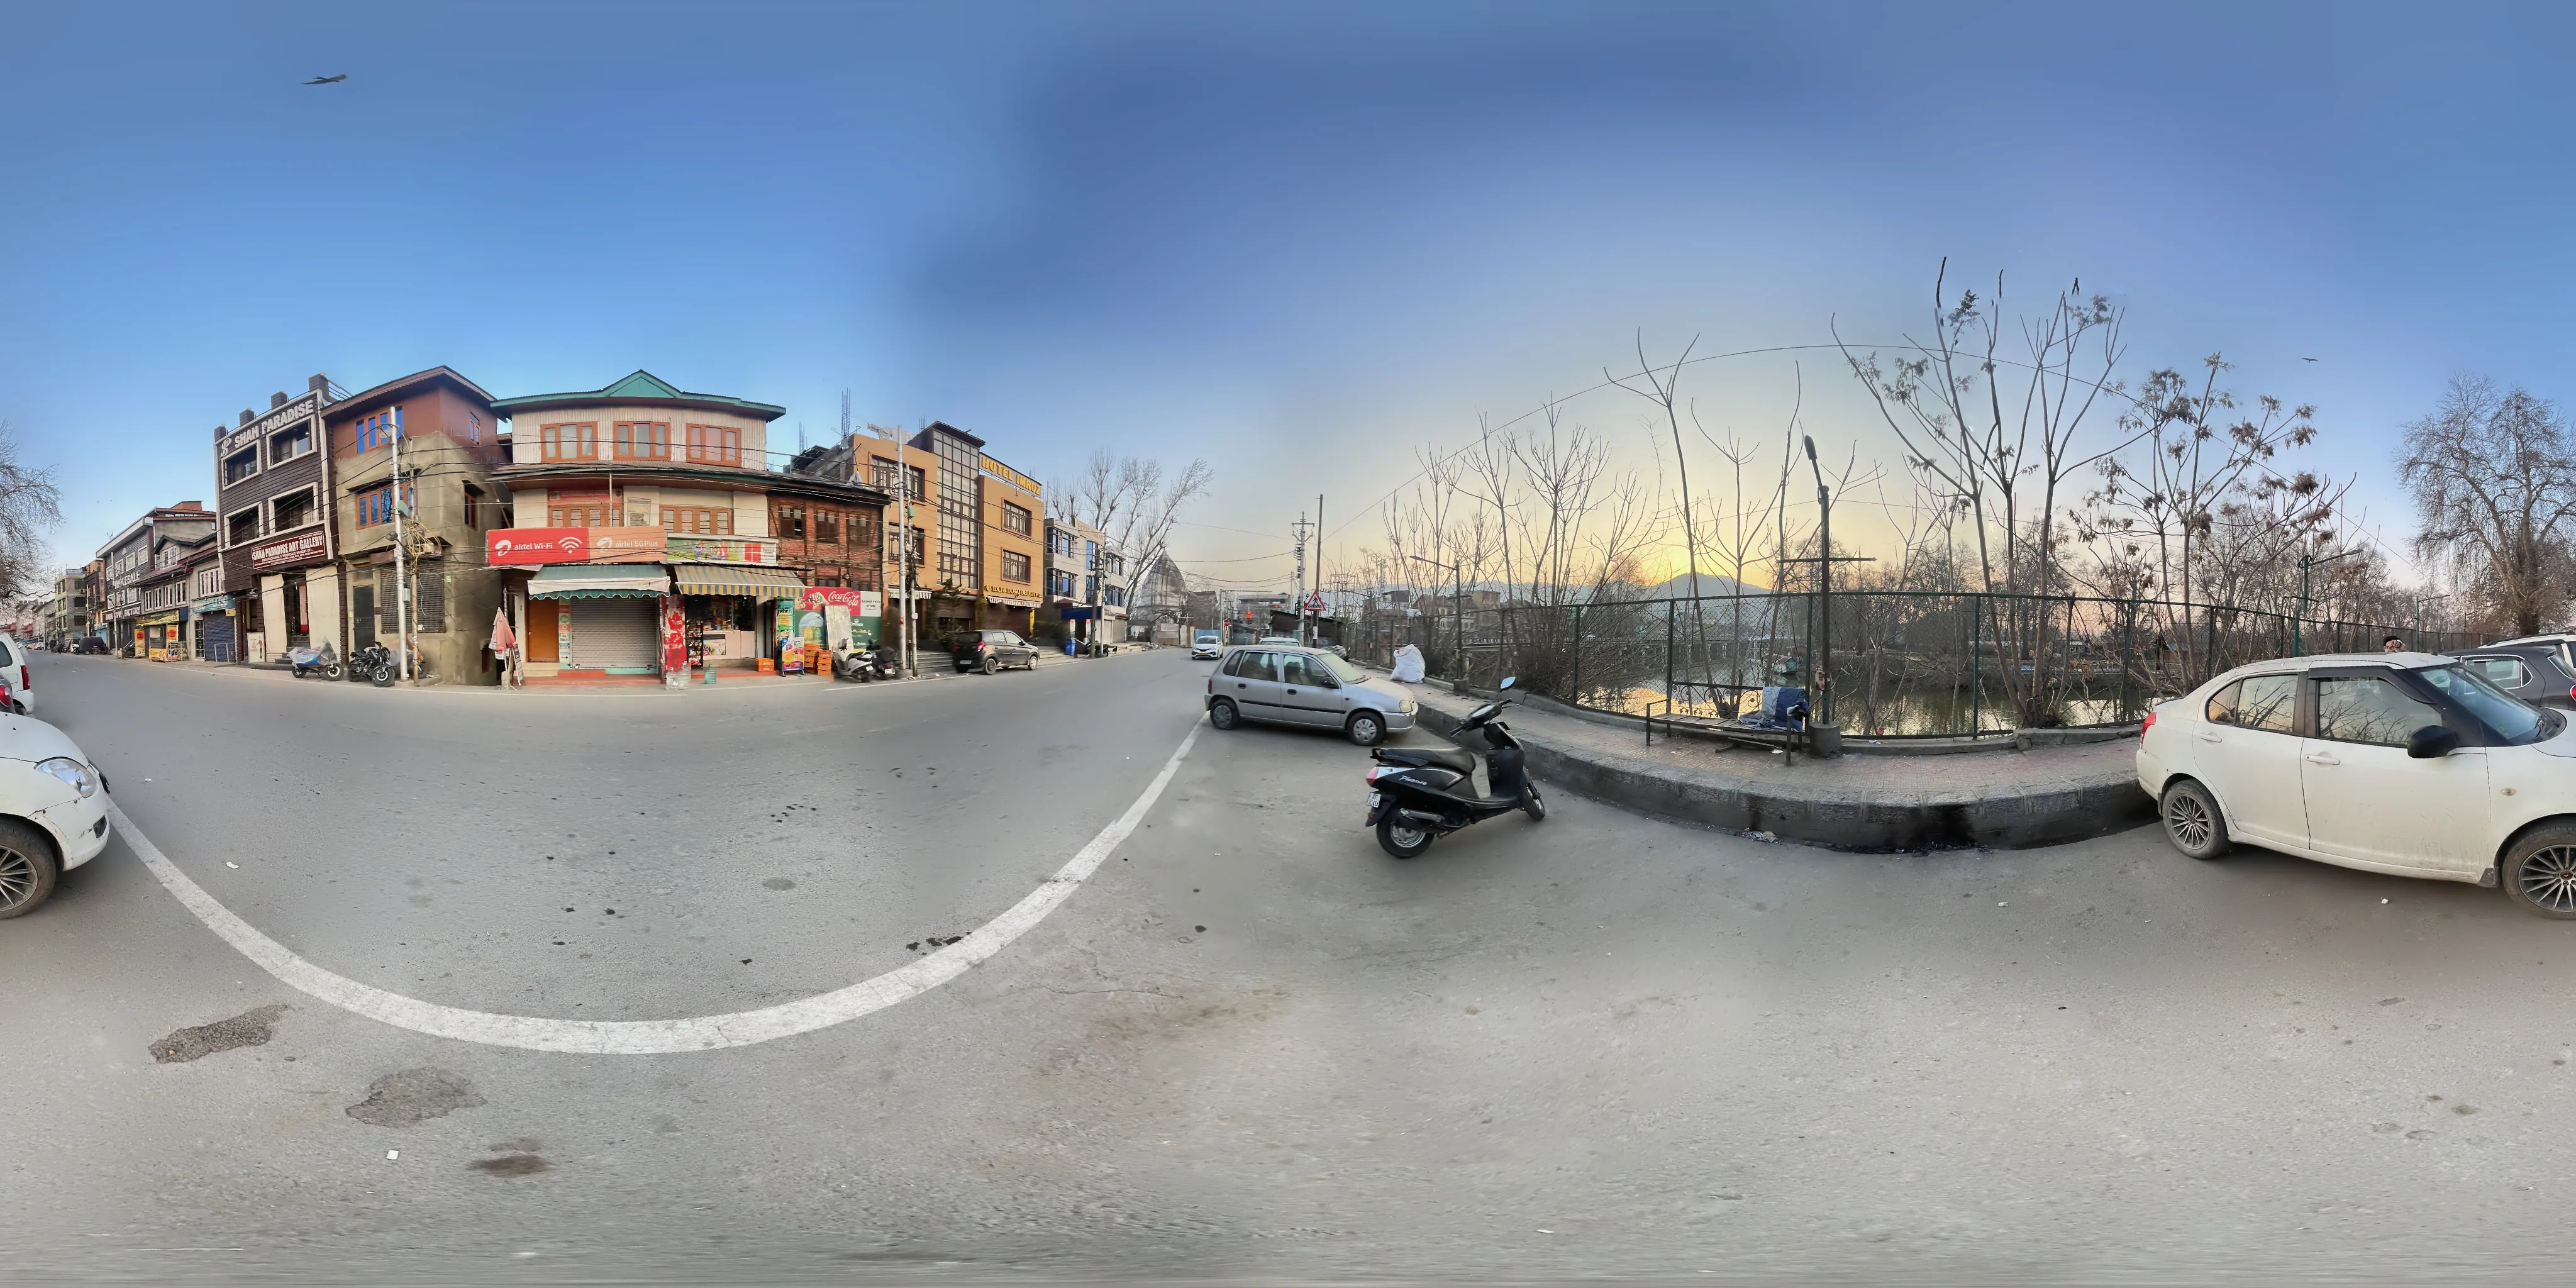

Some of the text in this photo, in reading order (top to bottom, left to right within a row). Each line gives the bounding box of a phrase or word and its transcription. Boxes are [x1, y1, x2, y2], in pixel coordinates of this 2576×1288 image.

[235, 425, 260, 448] SHAH
[261, 399, 314, 435] PARADISE
[982, 457, 1041, 496] HOTEL IMROZ
[253, 550, 265, 560] SHAH
[265, 543, 288, 557] PARADISE
[289, 540, 299, 552] ART
[299, 535, 323, 550] GALLERY
[828, 591, 860, 606] Coca-Cola
[124, 606, 141, 617] FACTORY
[1399, 775, 1428, 786] Pleasure
